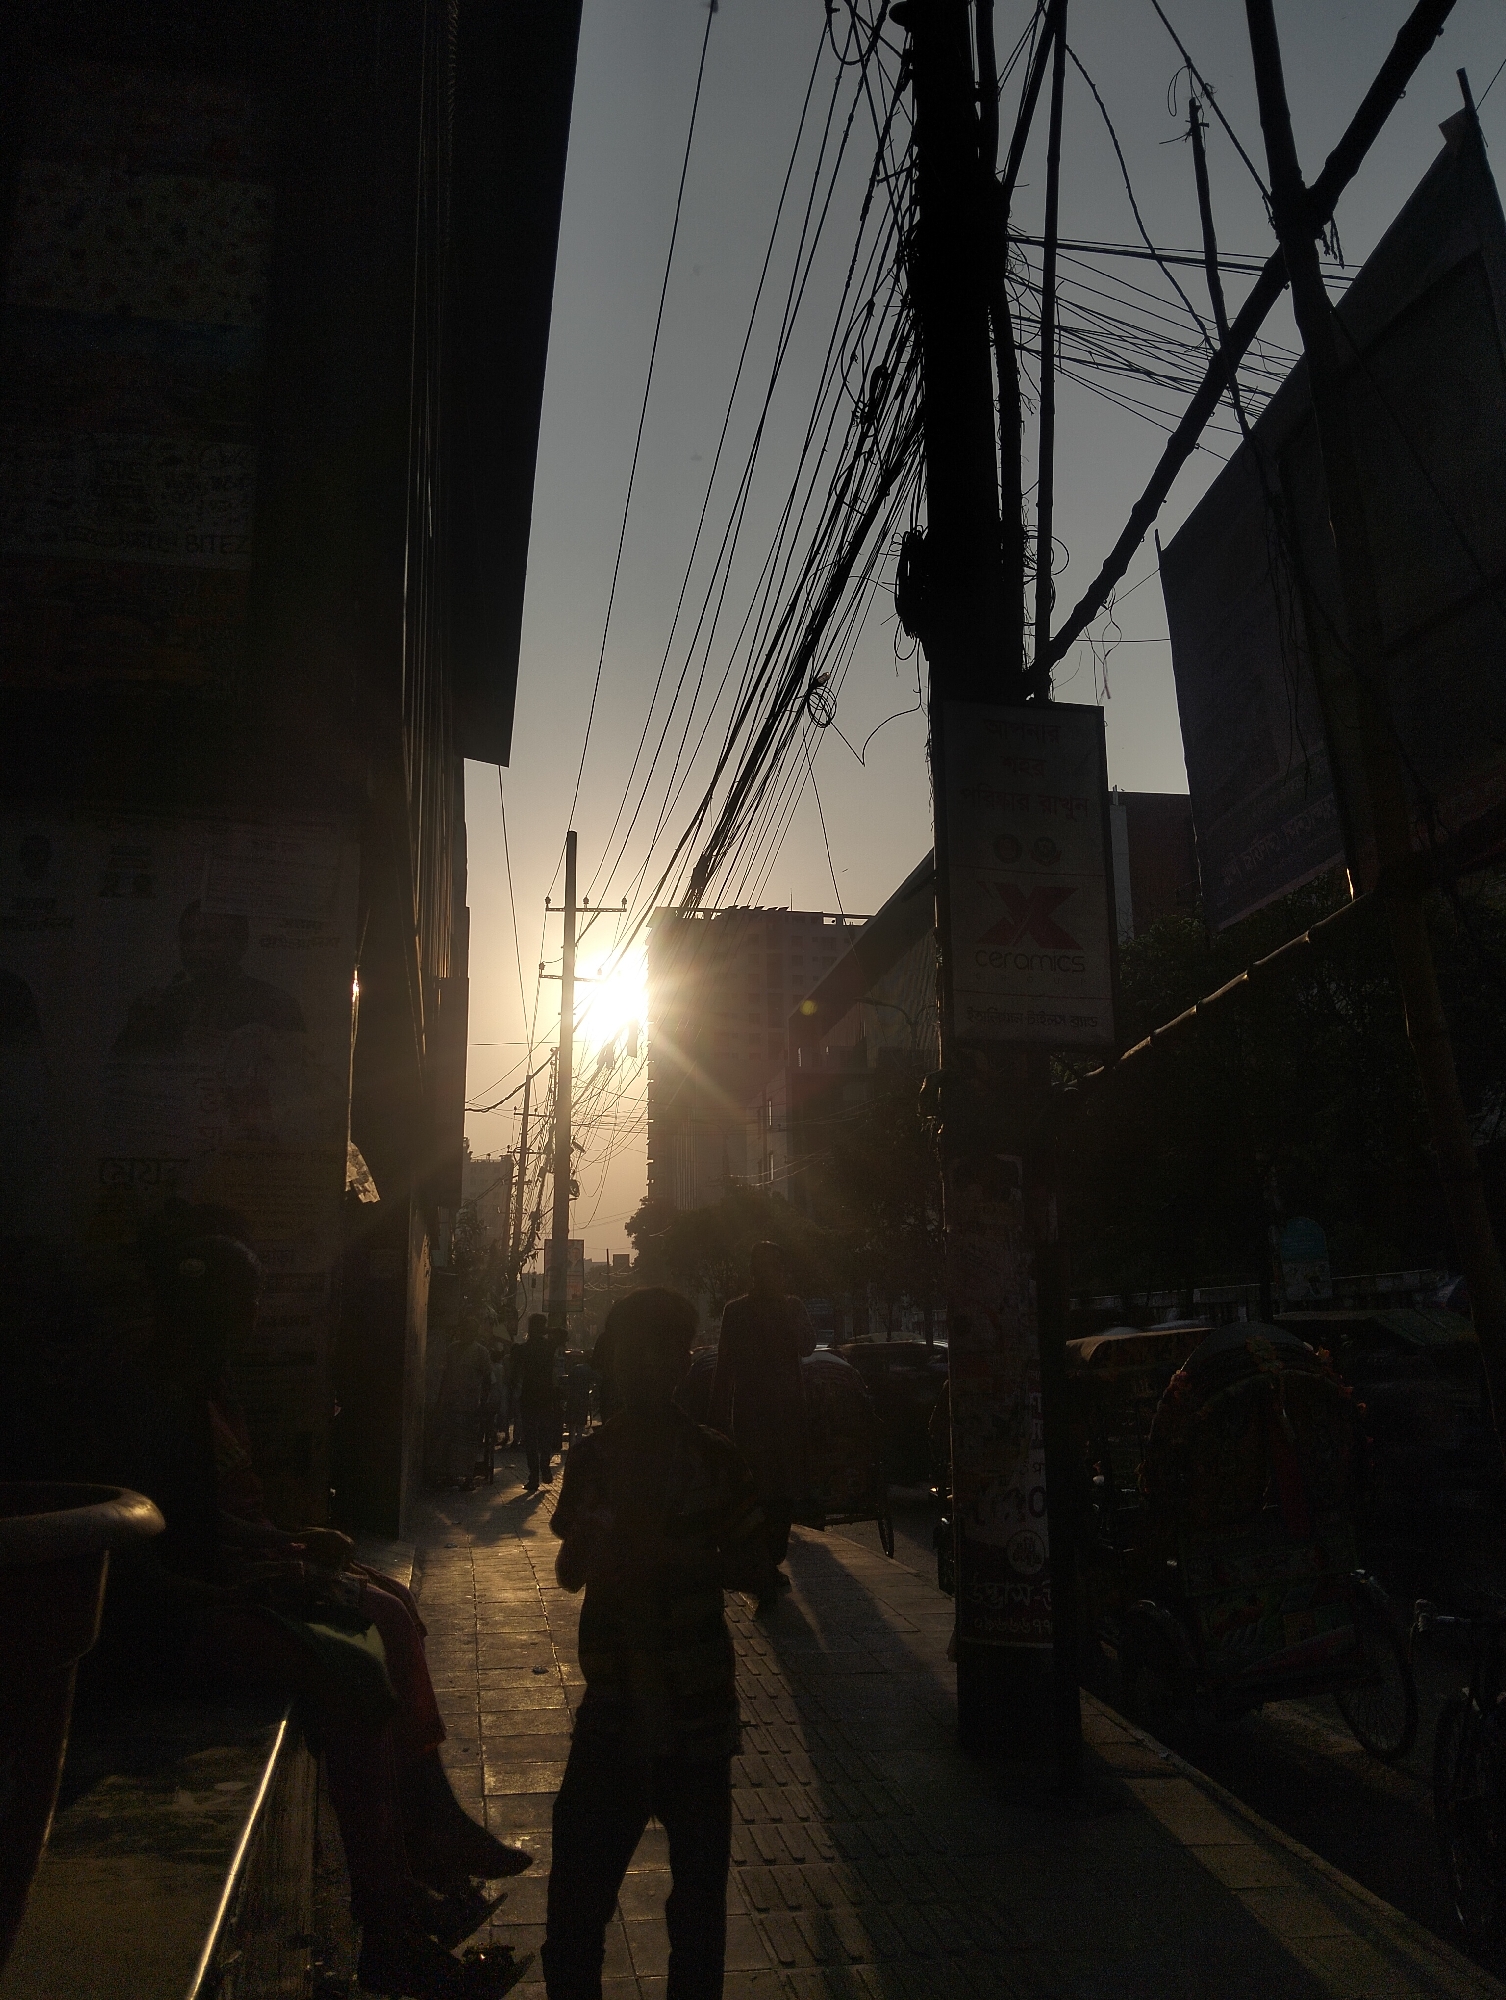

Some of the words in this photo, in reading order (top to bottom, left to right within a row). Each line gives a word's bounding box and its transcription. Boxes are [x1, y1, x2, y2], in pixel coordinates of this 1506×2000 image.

[982, 718, 1061, 744] আপনার
[999, 755, 1047, 778] শহর
[1037, 793, 1090, 822] রাখুন
[975, 949, 1086, 973] ceramics
